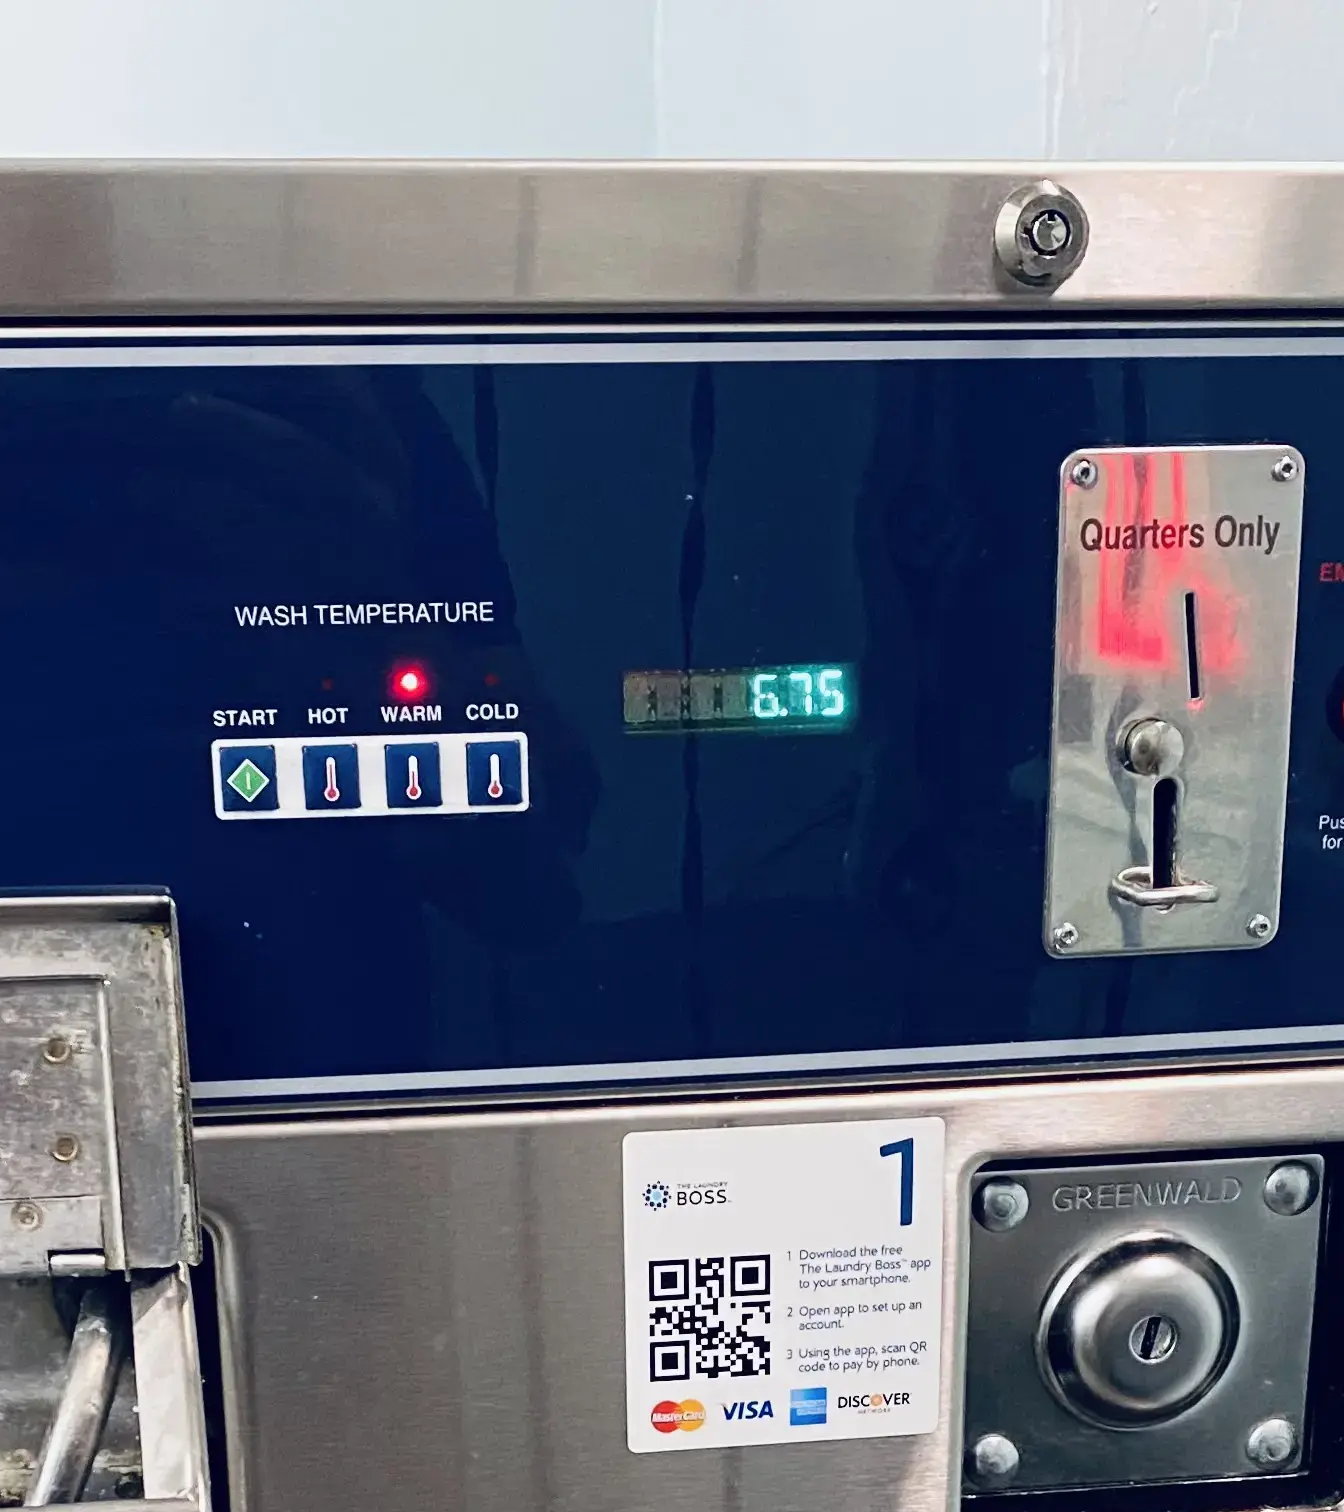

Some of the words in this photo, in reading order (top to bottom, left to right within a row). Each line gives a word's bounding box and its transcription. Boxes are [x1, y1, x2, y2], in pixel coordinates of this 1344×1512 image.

[1080, 518, 1205, 551] Quarters
[1214, 514, 1281, 555] Only
[234, 606, 307, 627] WASH
[313, 601, 494, 625] TEMPERATURE
[753, 669, 845, 718] 6.75
[212, 709, 278, 727] START
[308, 708, 348, 724] HOT
[381, 705, 442, 723] WARM
[465, 704, 519, 721] COLD
[1322, 834, 1343, 850] for
[879, 1138, 914, 1226] 1
[677, 1190, 727, 1206] BOSS
[1052, 1176, 1243, 1212] GREENWALD
[799, 1247, 857, 1260] Download
[860, 1246, 878, 1257] the
[881, 1245, 903, 1256] free
[800, 1263, 821, 1274] The
[825, 1260, 872, 1274] Laundry
[910, 1259, 931, 1271] app
[799, 1279, 810, 1289] to
[813, 1278, 837, 1291] your
[841, 1274, 911, 1287] smartphone.
[799, 1306, 830, 1319] Open
[834, 1305, 854, 1318] app
[858, 1303, 869, 1313] to
[872, 1303, 888, 1312] set
[892, 1302, 905, 1314] up
[909, 1301, 922, 1310] an
[799, 1319, 844, 1331] account.
[799, 1348, 830, 1360] Using
[833, 1345, 851, 1357] the
[855, 1347, 878, 1358] app,
[881, 1344, 906, 1354] scan
[910, 1341, 927, 1353] QR
[799, 1362, 826, 1372] code
[829, 1361, 840, 1371] to
[843, 1360, 863, 1373] pay
[867, 1357, 879, 1371] by
[883, 1357, 920, 1371] phone.
[838, 1392, 910, 1409] DISCOVER
[720, 1400, 774, 1421] VISA
